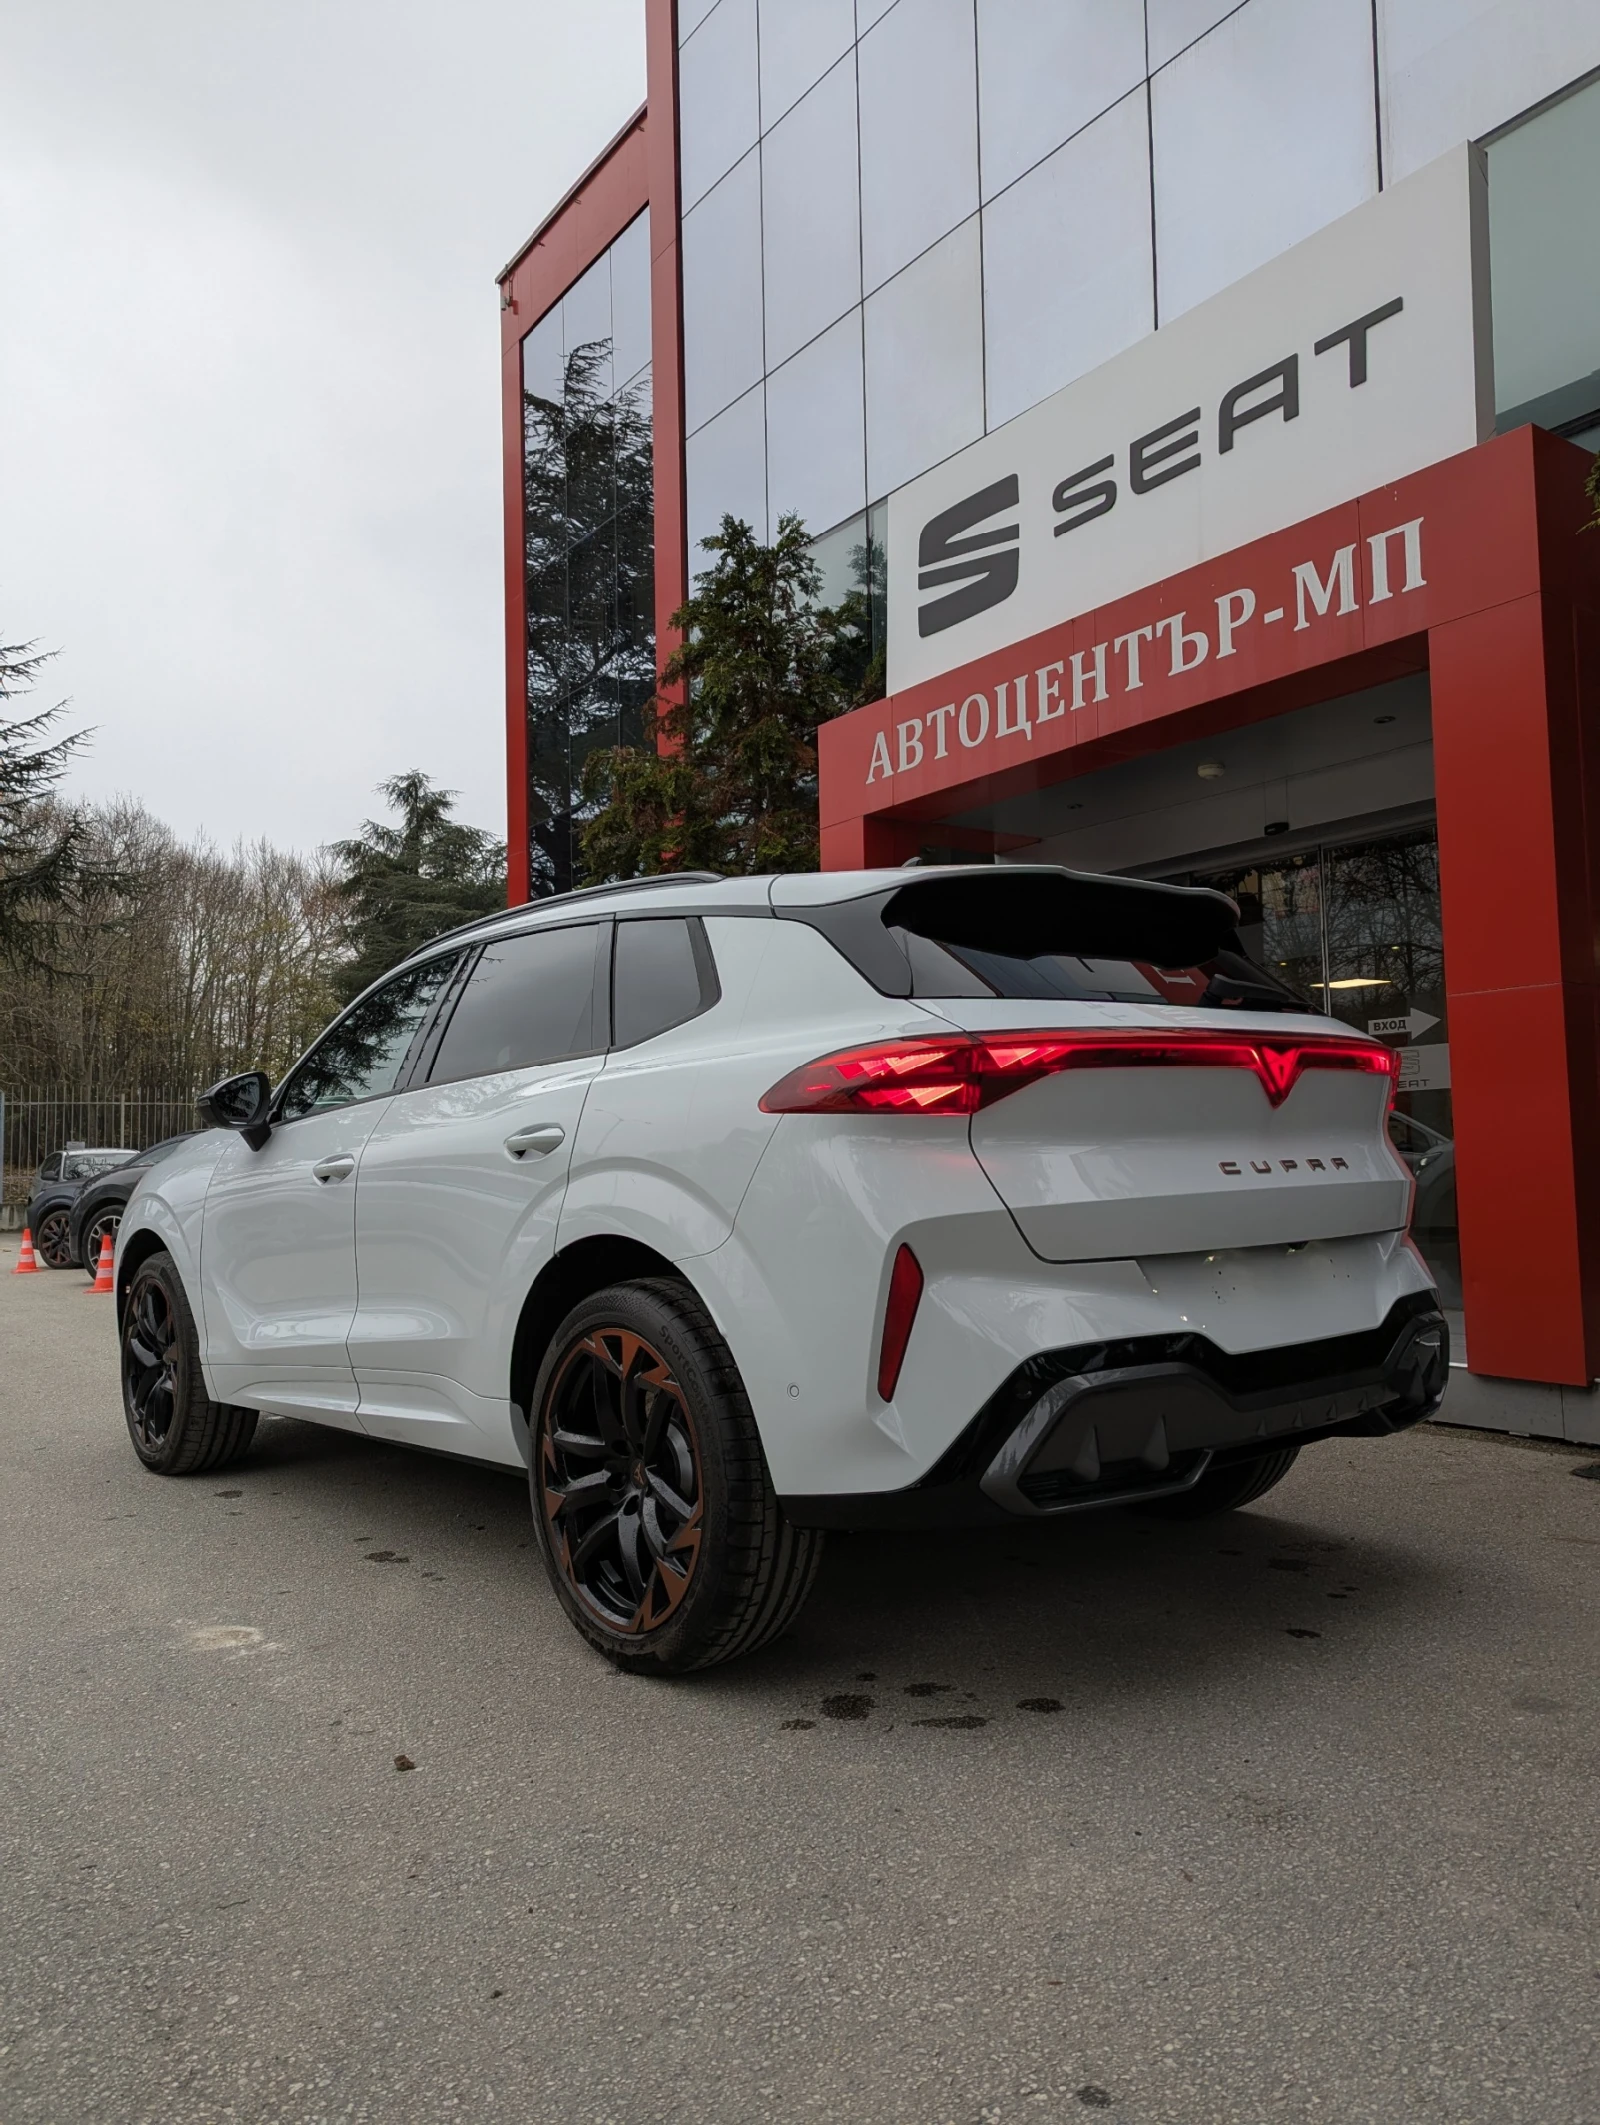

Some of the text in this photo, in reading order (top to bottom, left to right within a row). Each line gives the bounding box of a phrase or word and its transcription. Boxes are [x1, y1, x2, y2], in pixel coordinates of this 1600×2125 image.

[1052, 296, 1403, 538] SEAT
[865, 517, 1428, 785] АВТОЦЕНТЪР-МП
[1373, 1020, 1407, 1032] ВХОД
[1397, 1079, 1431, 1089] EAT
[1218, 1157, 1349, 1175] CUPRA
